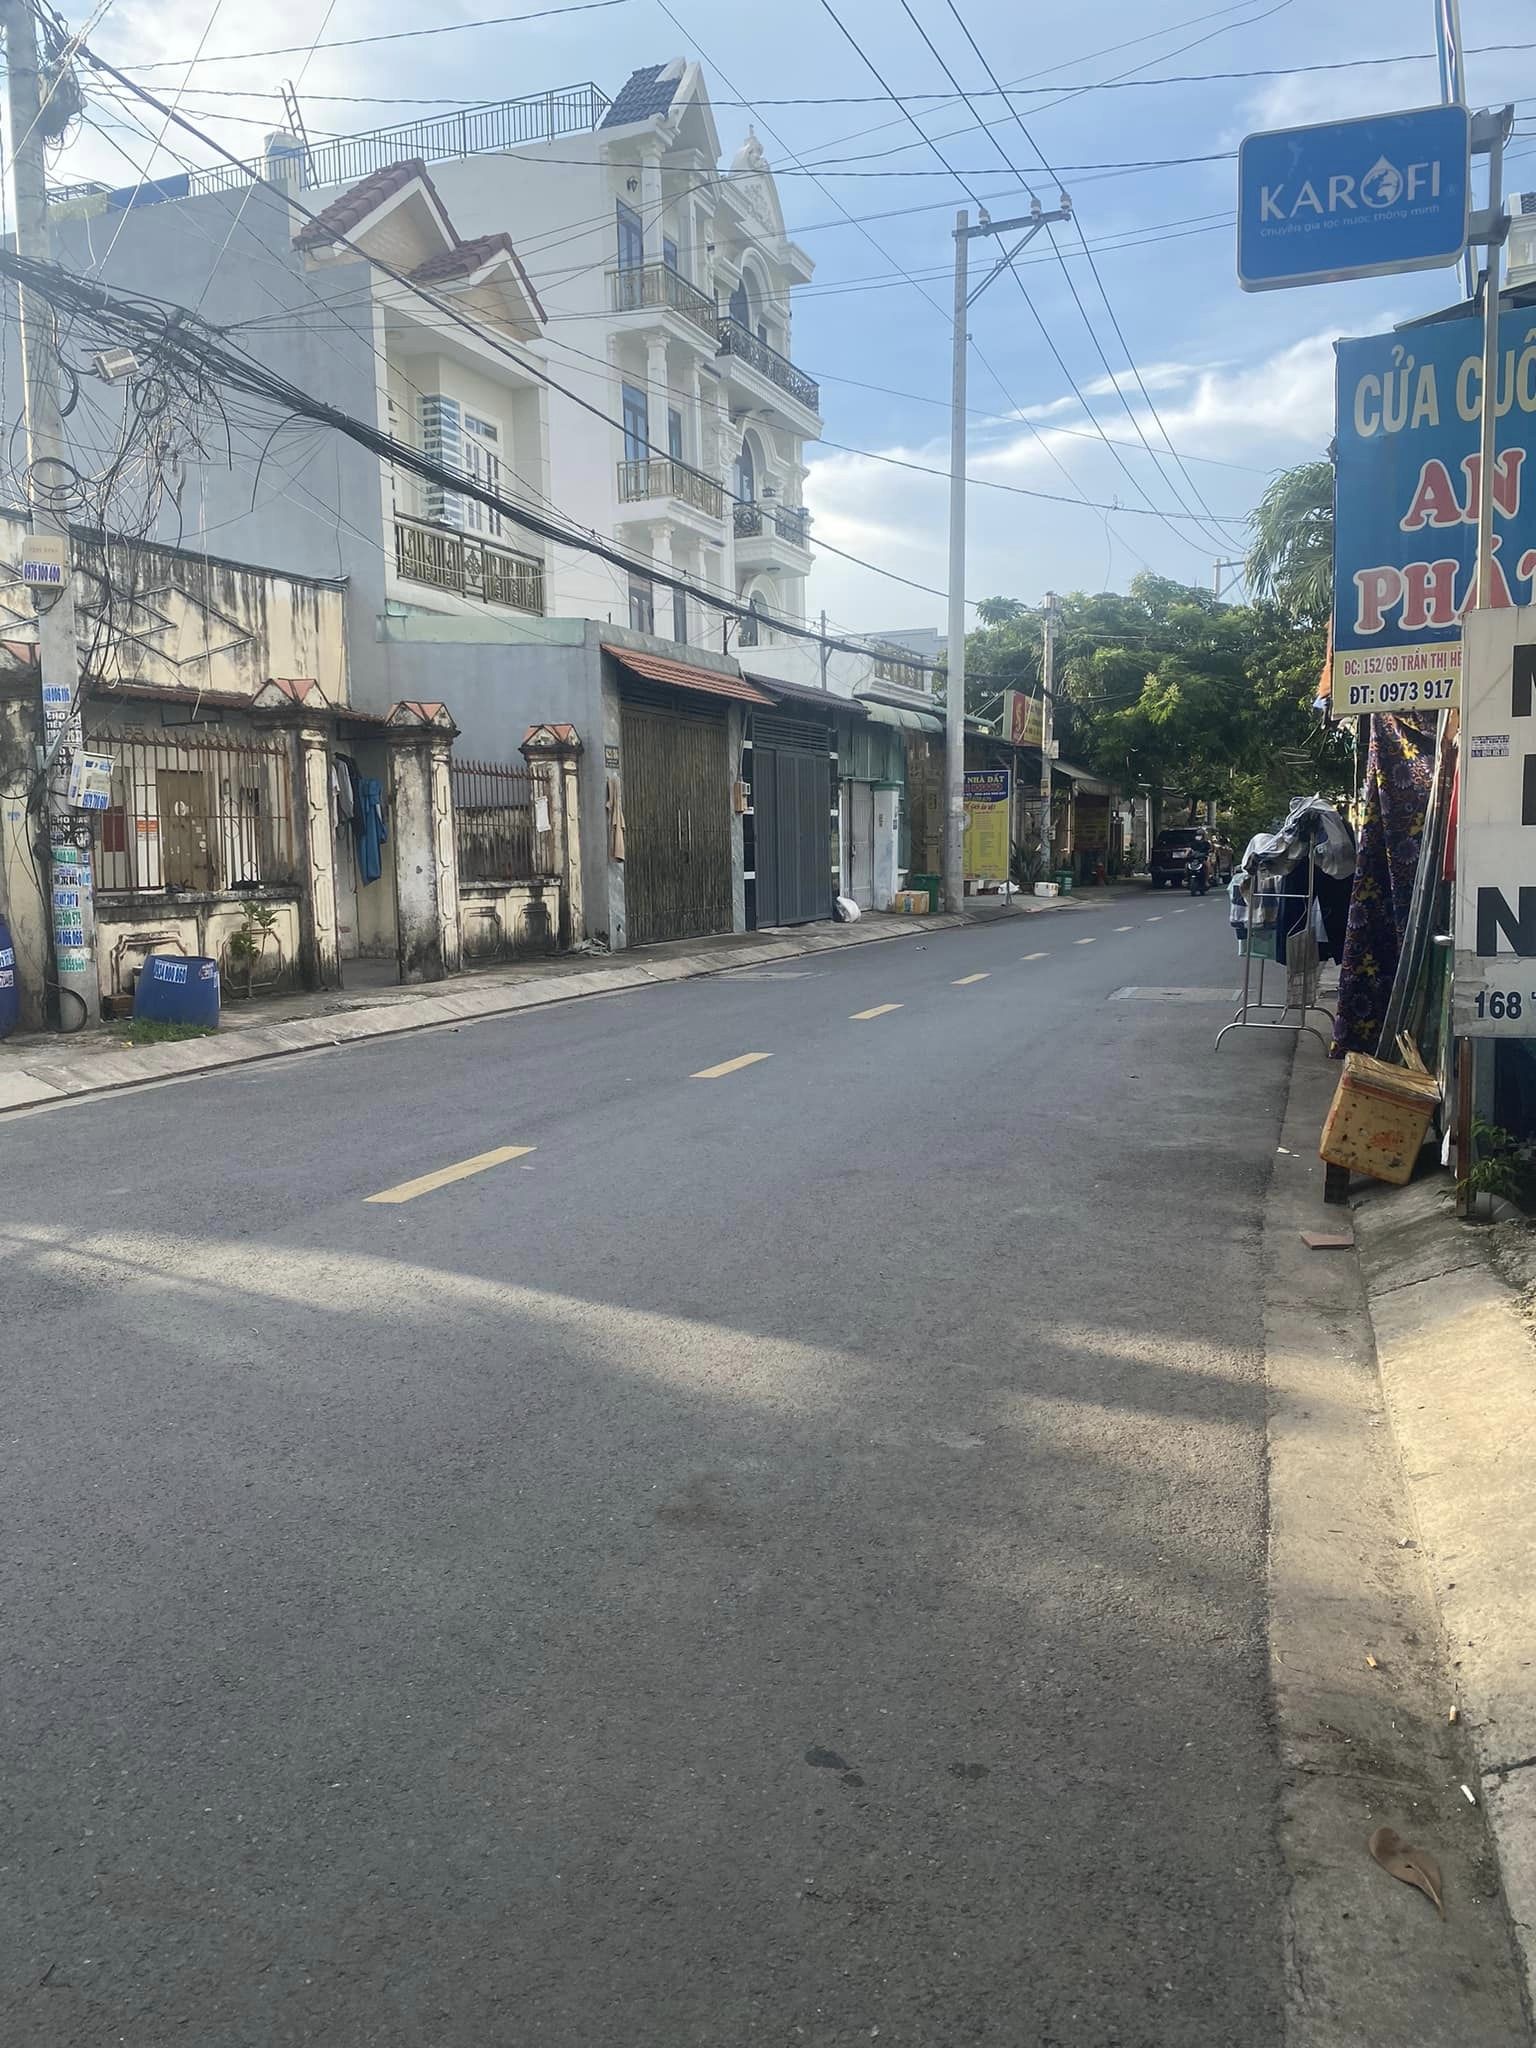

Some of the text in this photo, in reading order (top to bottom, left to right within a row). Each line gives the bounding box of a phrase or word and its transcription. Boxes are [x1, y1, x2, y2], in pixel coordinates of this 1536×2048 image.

[1261, 154, 1441, 222] KAROFI
[1354, 344, 1440, 438] CỬA
[1400, 447, 1526, 533] AN
[1344, 660, 1360, 675] ĐC:
[1364, 656, 1399, 674] 152/69
[1431, 652, 1447, 671] THỊ
[1350, 679, 1454, 704] ĐT: 0973 917
[967, 772, 1005, 783] NHÀ ĐẤT
[1475, 991, 1522, 1019] 168
